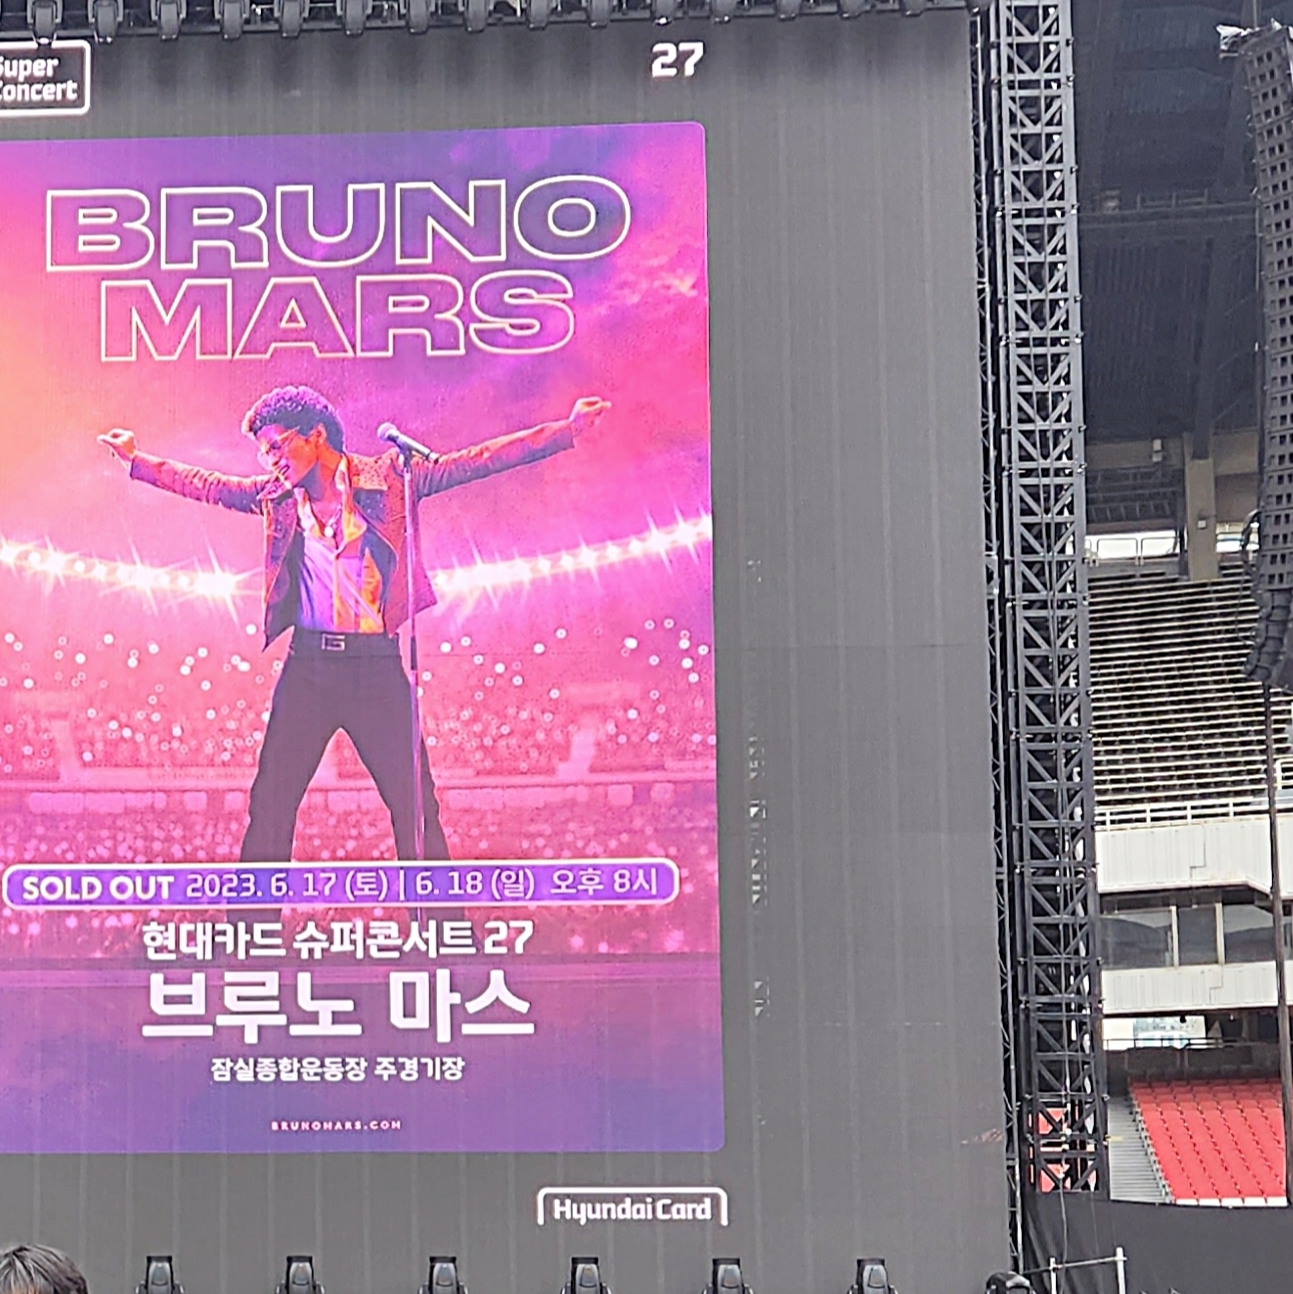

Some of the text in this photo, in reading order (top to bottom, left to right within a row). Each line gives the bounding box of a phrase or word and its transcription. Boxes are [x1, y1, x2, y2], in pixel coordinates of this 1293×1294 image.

[651, 41, 704, 77] 27
[45, 174, 632, 272] BRUNO
[100, 269, 575, 362] MARS
[22, 875, 103, 900] SOLD
[109, 876, 175, 899] OUT
[185, 874, 263, 897] 2023.
[269, 873, 294, 897] 6.
[303, 872, 337, 897] 17
[415, 872, 440, 895] 6.
[447, 871, 483, 895] 18
[549, 868, 604, 896] 오후
[613, 868, 658, 895] 8시
[142, 920, 534, 961] 현대카드 슈퍼콘서트 27
[142, 968, 535, 1044] 브루노 마스
[211, 1056, 466, 1082] 잠실종합운동장 주경기장
[553, 1197, 712, 1226] Hyundai Card
